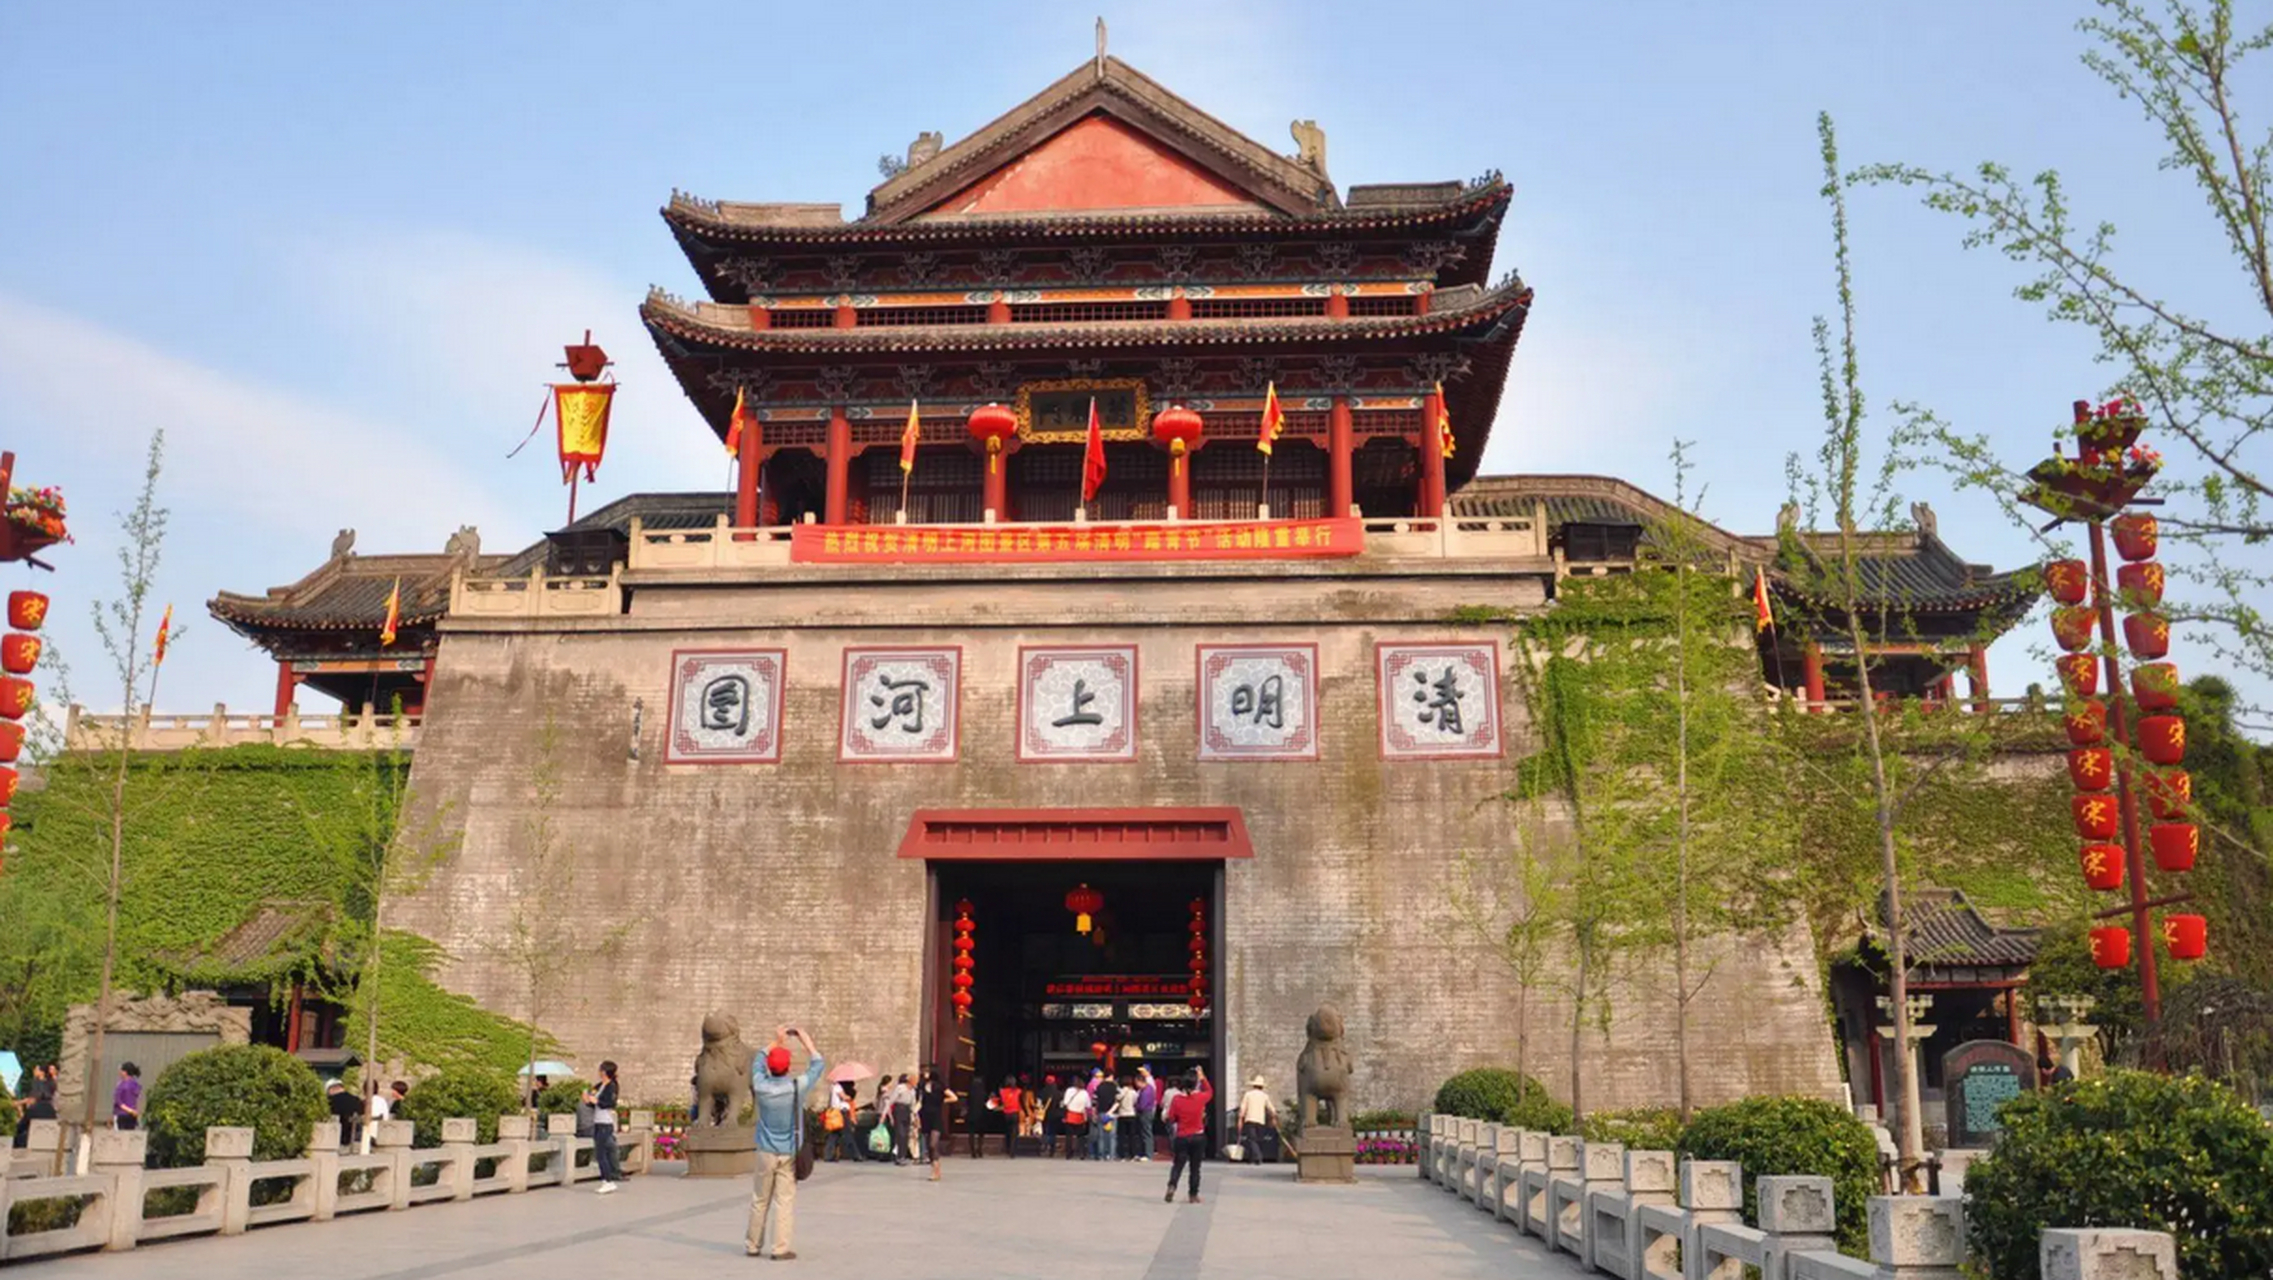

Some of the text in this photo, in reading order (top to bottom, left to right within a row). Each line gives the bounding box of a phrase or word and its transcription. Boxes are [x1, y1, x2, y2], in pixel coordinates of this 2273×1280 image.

[22, 597, 45, 622] 宋
[20, 638, 40, 663] 宋
[2069, 656, 2093, 682] 宋
[871, 675, 930, 733] 河
[1052, 679, 1102, 727] 上
[1231, 674, 1284, 728] 明
[1413, 665, 1464, 735] 清
[2078, 750, 2102, 777] 宋
[2082, 800, 2106, 827] 宋
[2083, 850, 2107, 877] 宋
